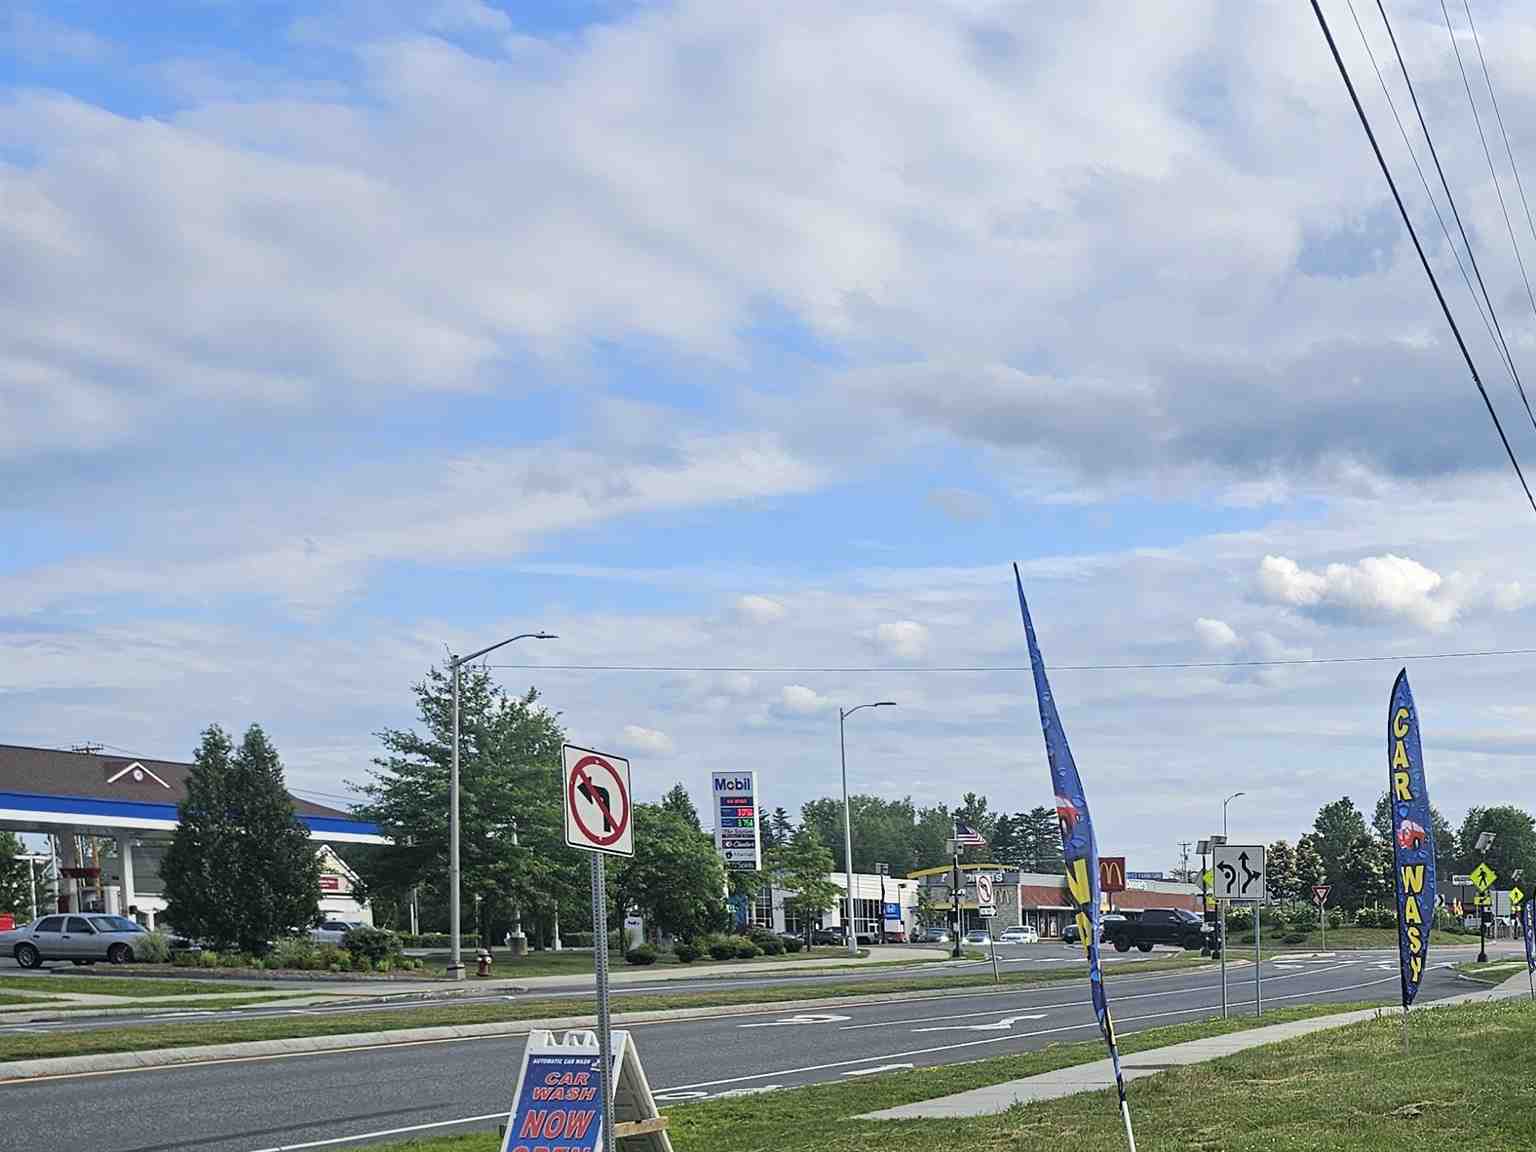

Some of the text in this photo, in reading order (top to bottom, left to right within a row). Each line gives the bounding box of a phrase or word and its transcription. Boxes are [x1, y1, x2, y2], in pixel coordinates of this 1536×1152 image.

[1393, 708, 1412, 800] CAR
[714, 778, 751, 791] Mobil
[544, 1072, 591, 1086] CAR
[532, 1087, 597, 1101] WASH
[519, 1110, 595, 1140] NOW
